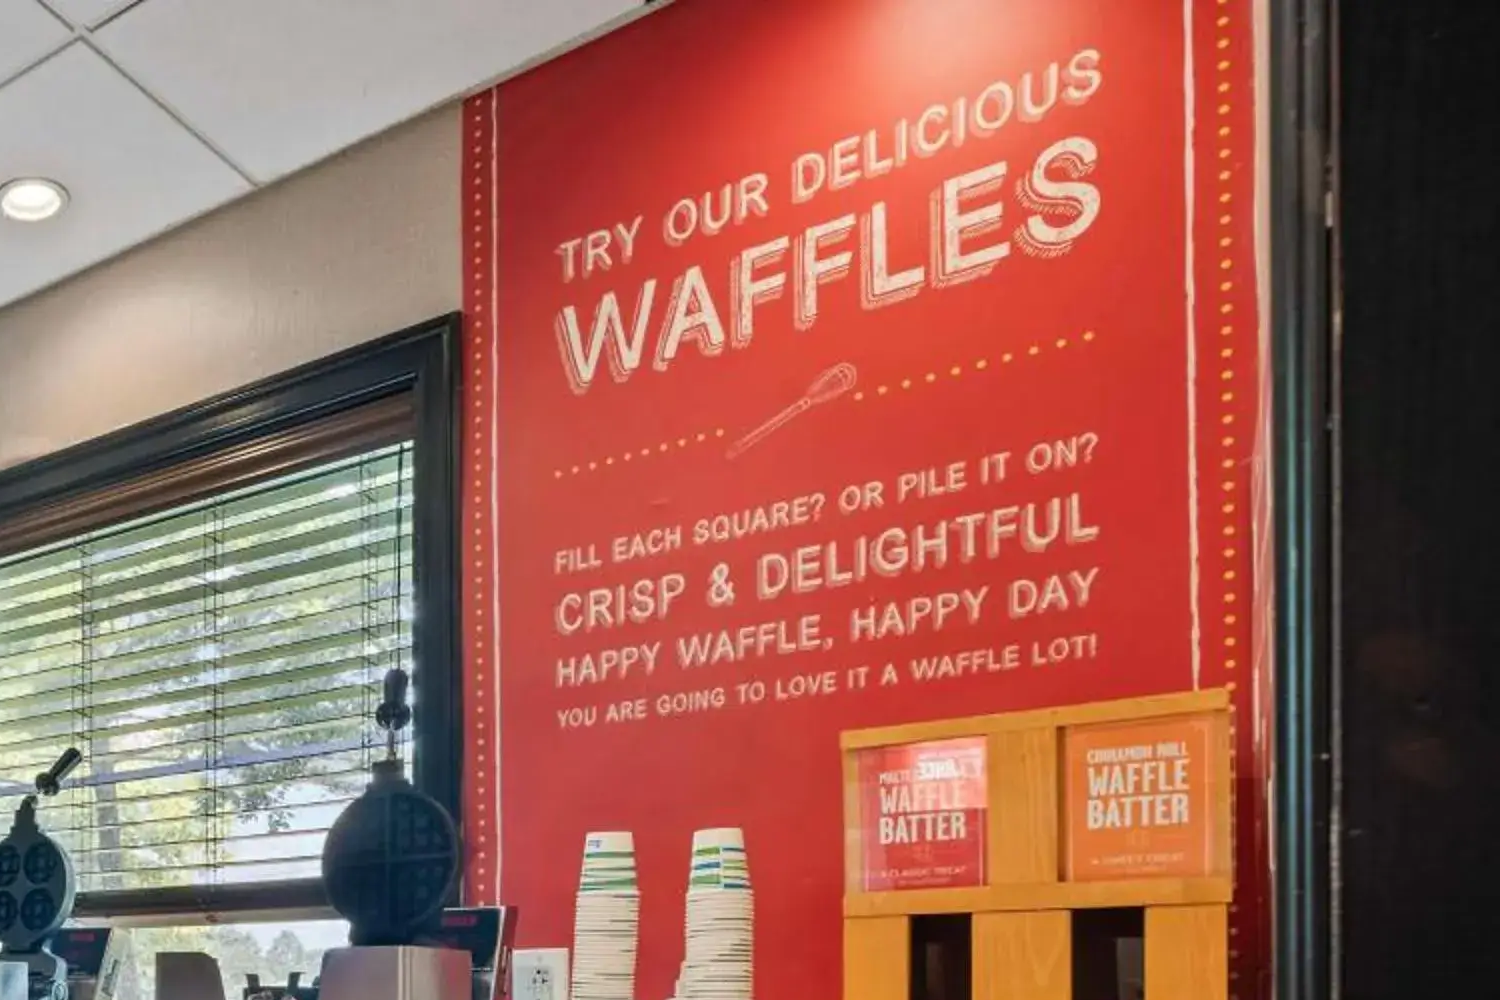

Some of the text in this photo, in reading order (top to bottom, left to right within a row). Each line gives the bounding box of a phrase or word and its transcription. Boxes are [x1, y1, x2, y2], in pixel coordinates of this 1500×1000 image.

[555, 48, 1102, 282] TRY OUR DELICIOUS
[555, 136, 1101, 395] WAFFLES
[555, 432, 1099, 574] FILL EACH SQUARE? OR PILE IT ON?
[555, 492, 1099, 636] CRISP & DELIGHTFUL
[556, 567, 1099, 688] HAPPY WAFFLE, HAPPY DAY
[556, 632, 1099, 729] YOU ARE GOING TO LOVE IT A WAFFLE LOT!
[879, 781, 966, 815] WAFFLE
[879, 811, 966, 845] BATTER
[1086, 758, 1190, 796] WAFFLE
[1086, 793, 1190, 831] BATTER
